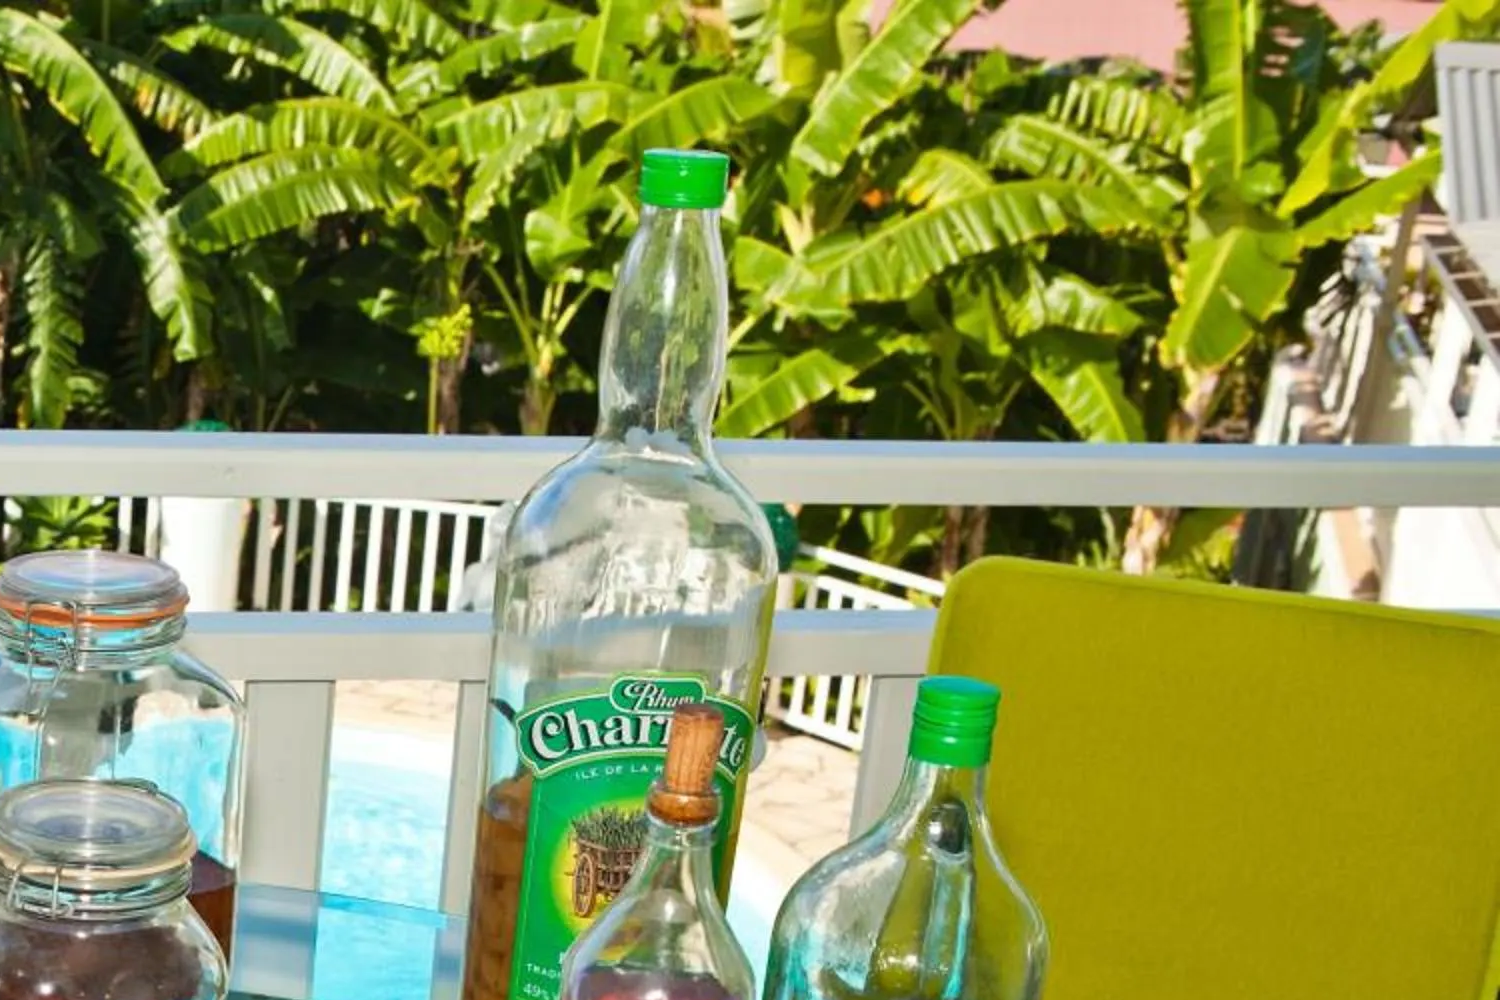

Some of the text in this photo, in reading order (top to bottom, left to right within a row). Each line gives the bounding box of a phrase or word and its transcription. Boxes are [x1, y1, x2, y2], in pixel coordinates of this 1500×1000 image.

[623, 680, 695, 712] Rhum
[531, 708, 746, 767] Charte
[605, 764, 624, 775] DE
[631, 763, 649, 773] LA
